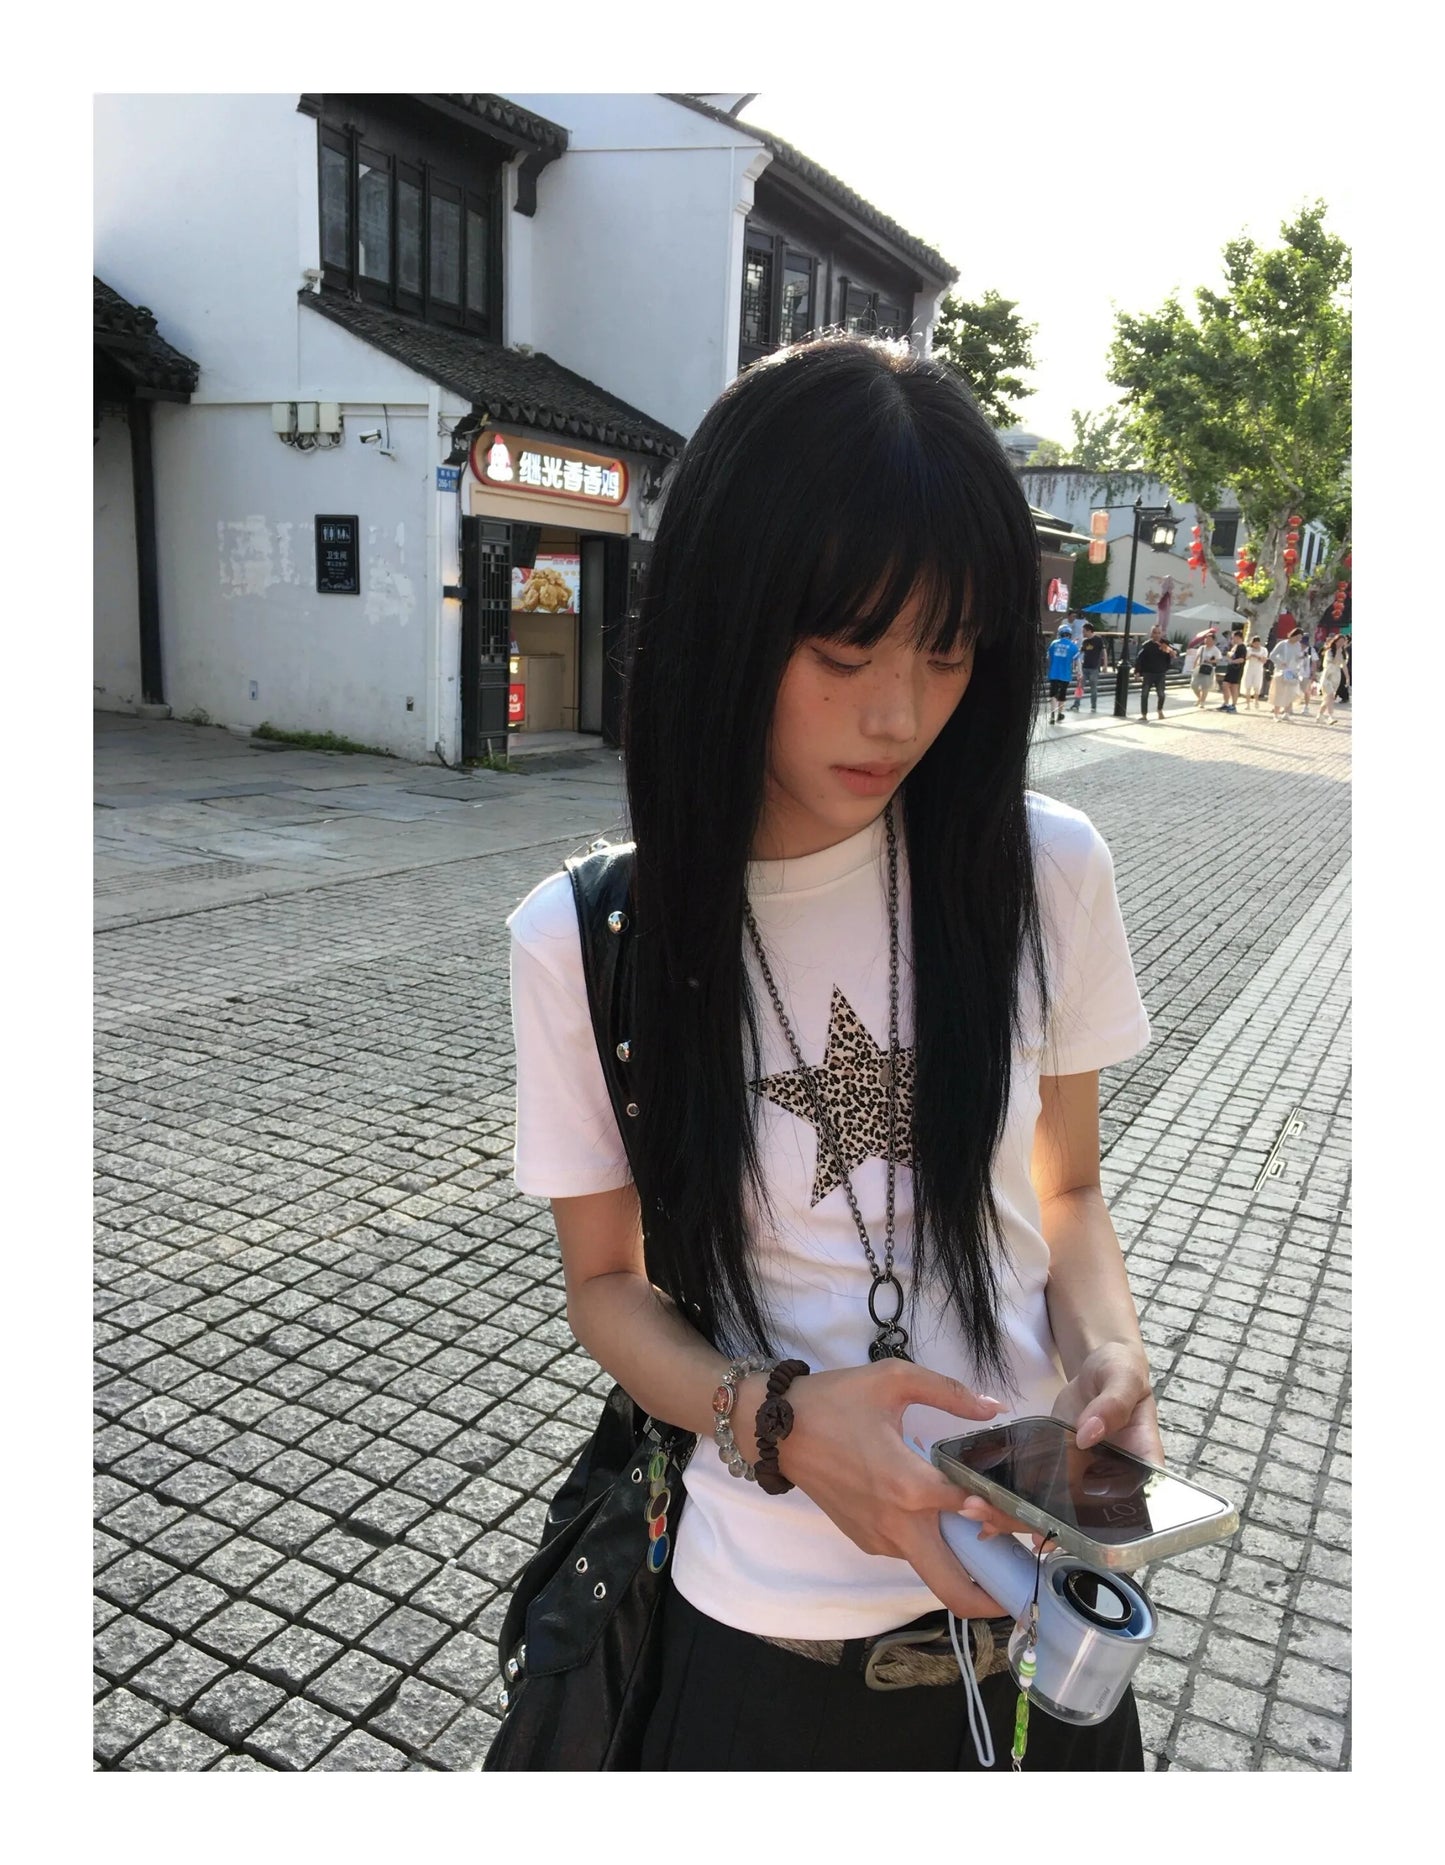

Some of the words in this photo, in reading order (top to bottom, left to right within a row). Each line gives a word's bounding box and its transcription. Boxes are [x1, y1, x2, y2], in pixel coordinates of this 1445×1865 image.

[519, 451, 619, 500] 继光香香鸡
[326, 550, 347, 560] 卫生间
